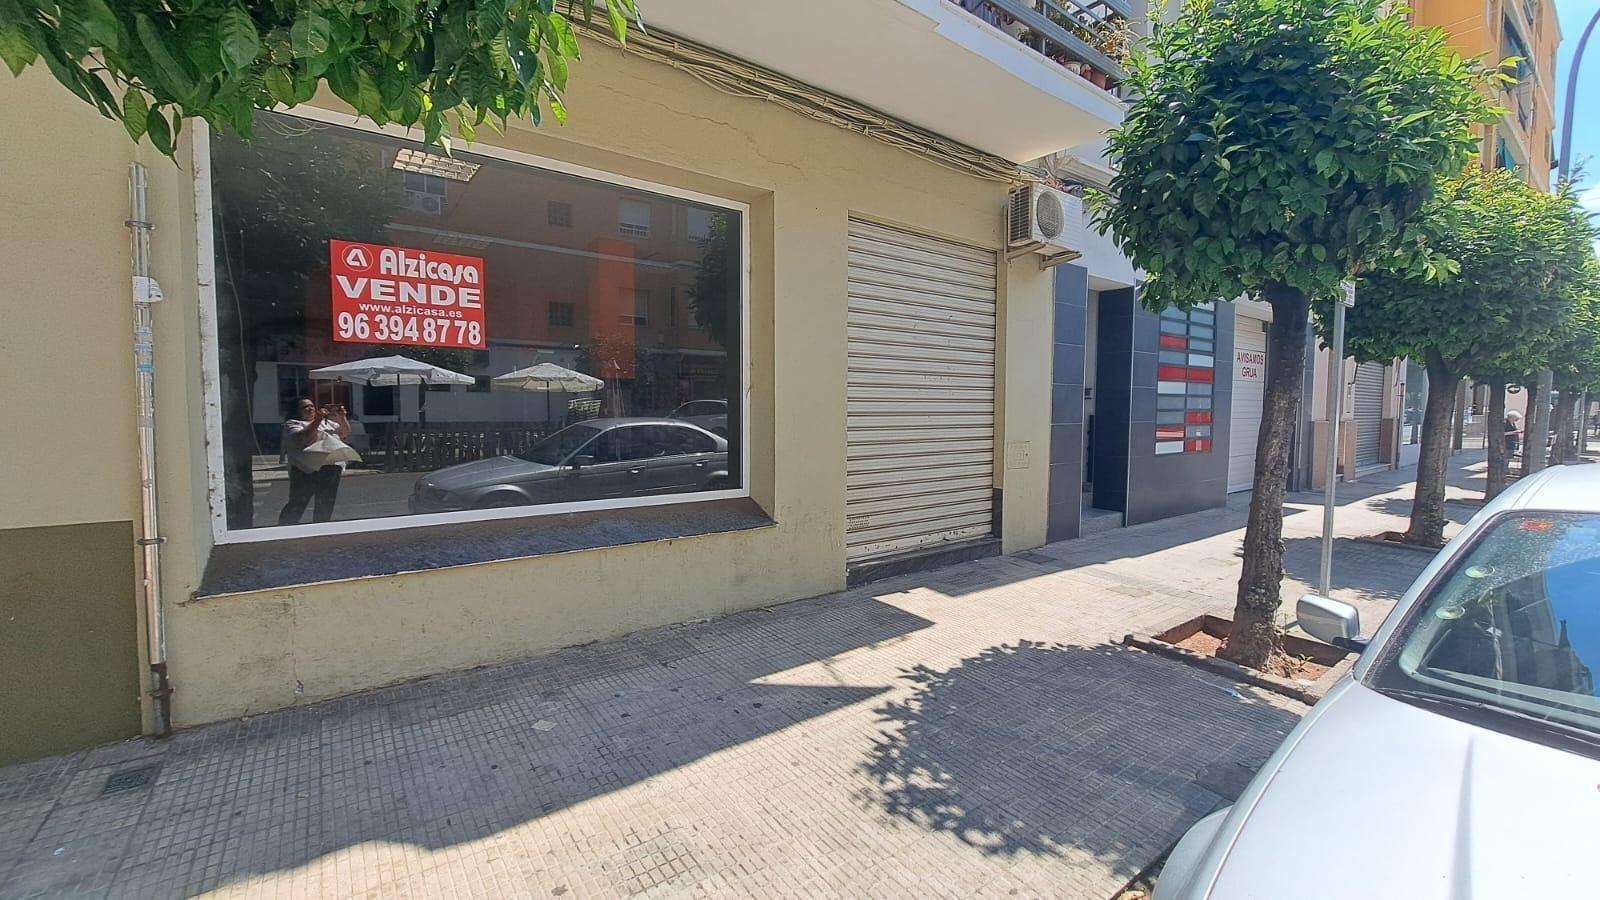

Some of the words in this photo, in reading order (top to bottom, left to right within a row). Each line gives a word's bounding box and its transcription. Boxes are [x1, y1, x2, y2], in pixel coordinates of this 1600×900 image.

[379, 248, 479, 285] Alzicasa
[336, 275, 481, 309] VENDE
[359, 302, 463, 318] www.alzicasa.es
[338, 311, 370, 339] 96
[374, 314, 419, 342] 394
[422, 317, 451, 343] 87
[454, 320, 481, 345] 78
[1236, 351, 1264, 365] AVISAMOS
[1241, 366, 1257, 378] GRUA
